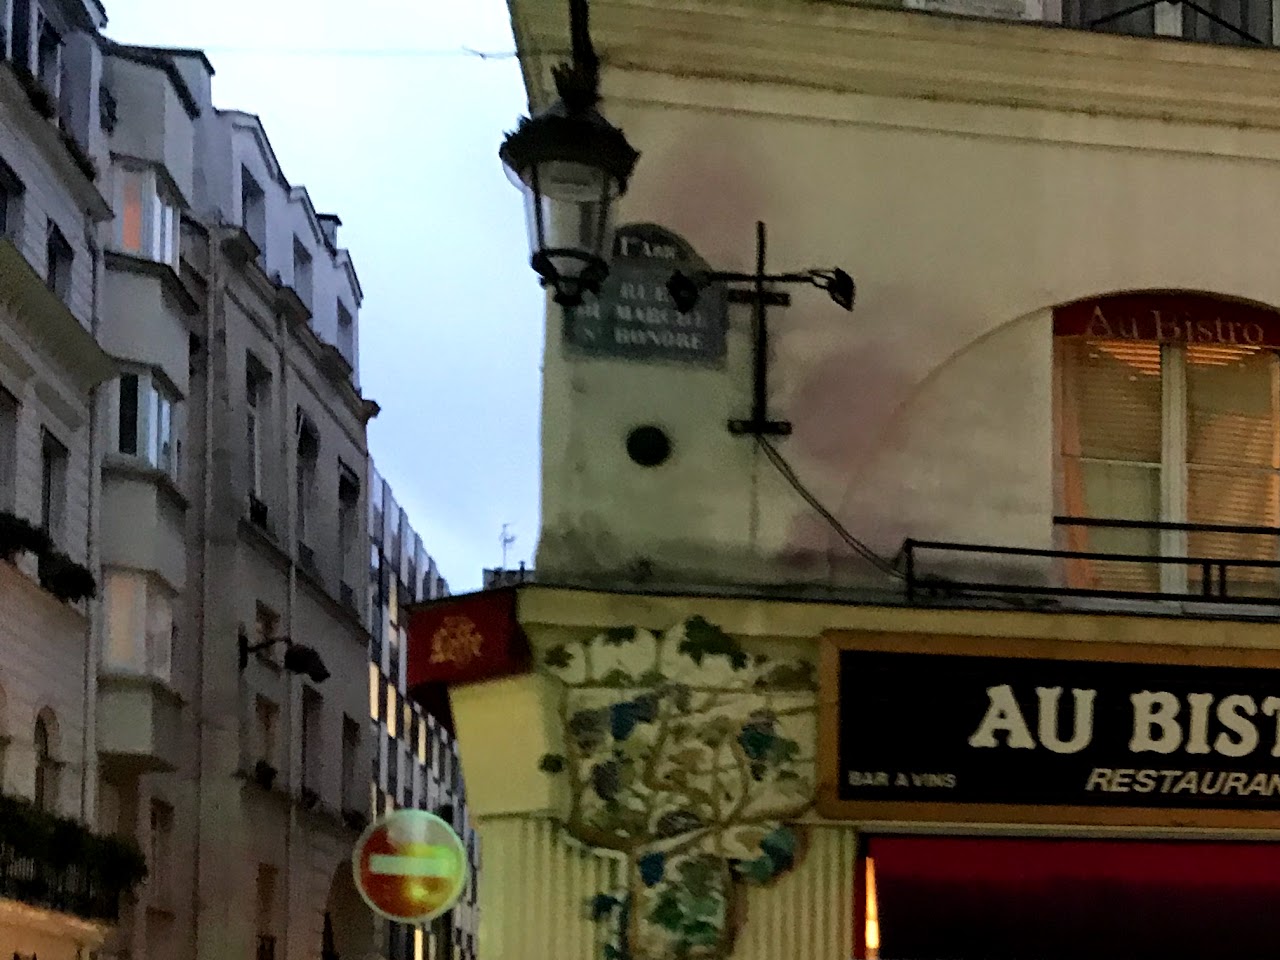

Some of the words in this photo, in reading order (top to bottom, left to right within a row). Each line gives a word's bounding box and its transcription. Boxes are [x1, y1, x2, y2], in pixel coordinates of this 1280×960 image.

[1086, 304, 1139, 339] Au
[1151, 309, 1264, 343] Bistro
[967, 683, 1098, 755] AU
[847, 770, 889, 787] BAR
[893, 771, 909, 787] A
[910, 772, 957, 789] VINS
